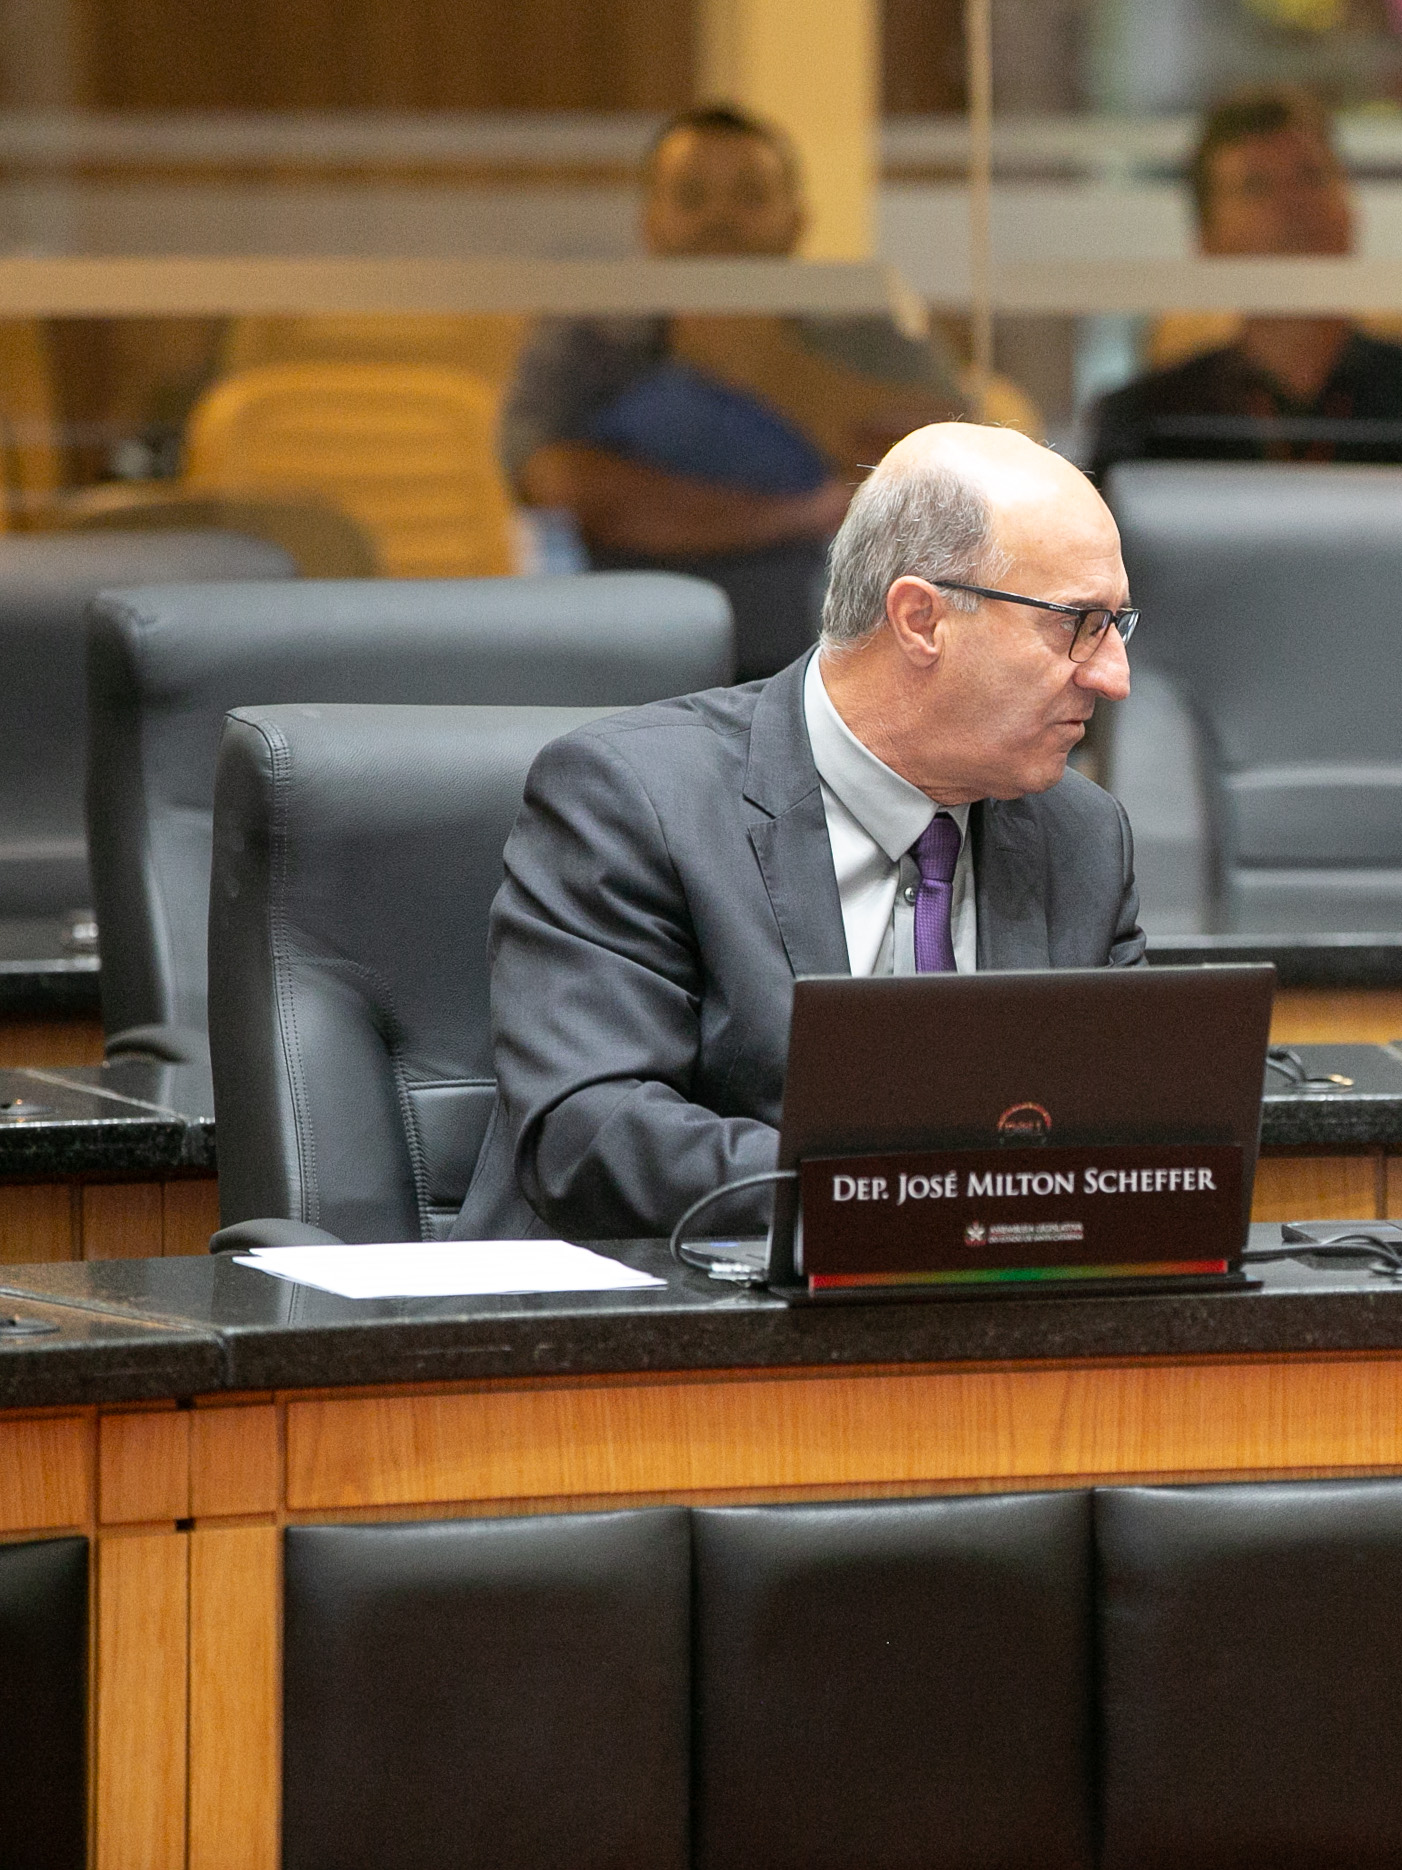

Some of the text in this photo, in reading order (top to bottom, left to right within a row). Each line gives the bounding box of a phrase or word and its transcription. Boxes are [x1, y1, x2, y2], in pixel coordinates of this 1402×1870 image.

[832, 1166, 1217, 1206] DEP. JOSÉ MILTON SCHEFFER
